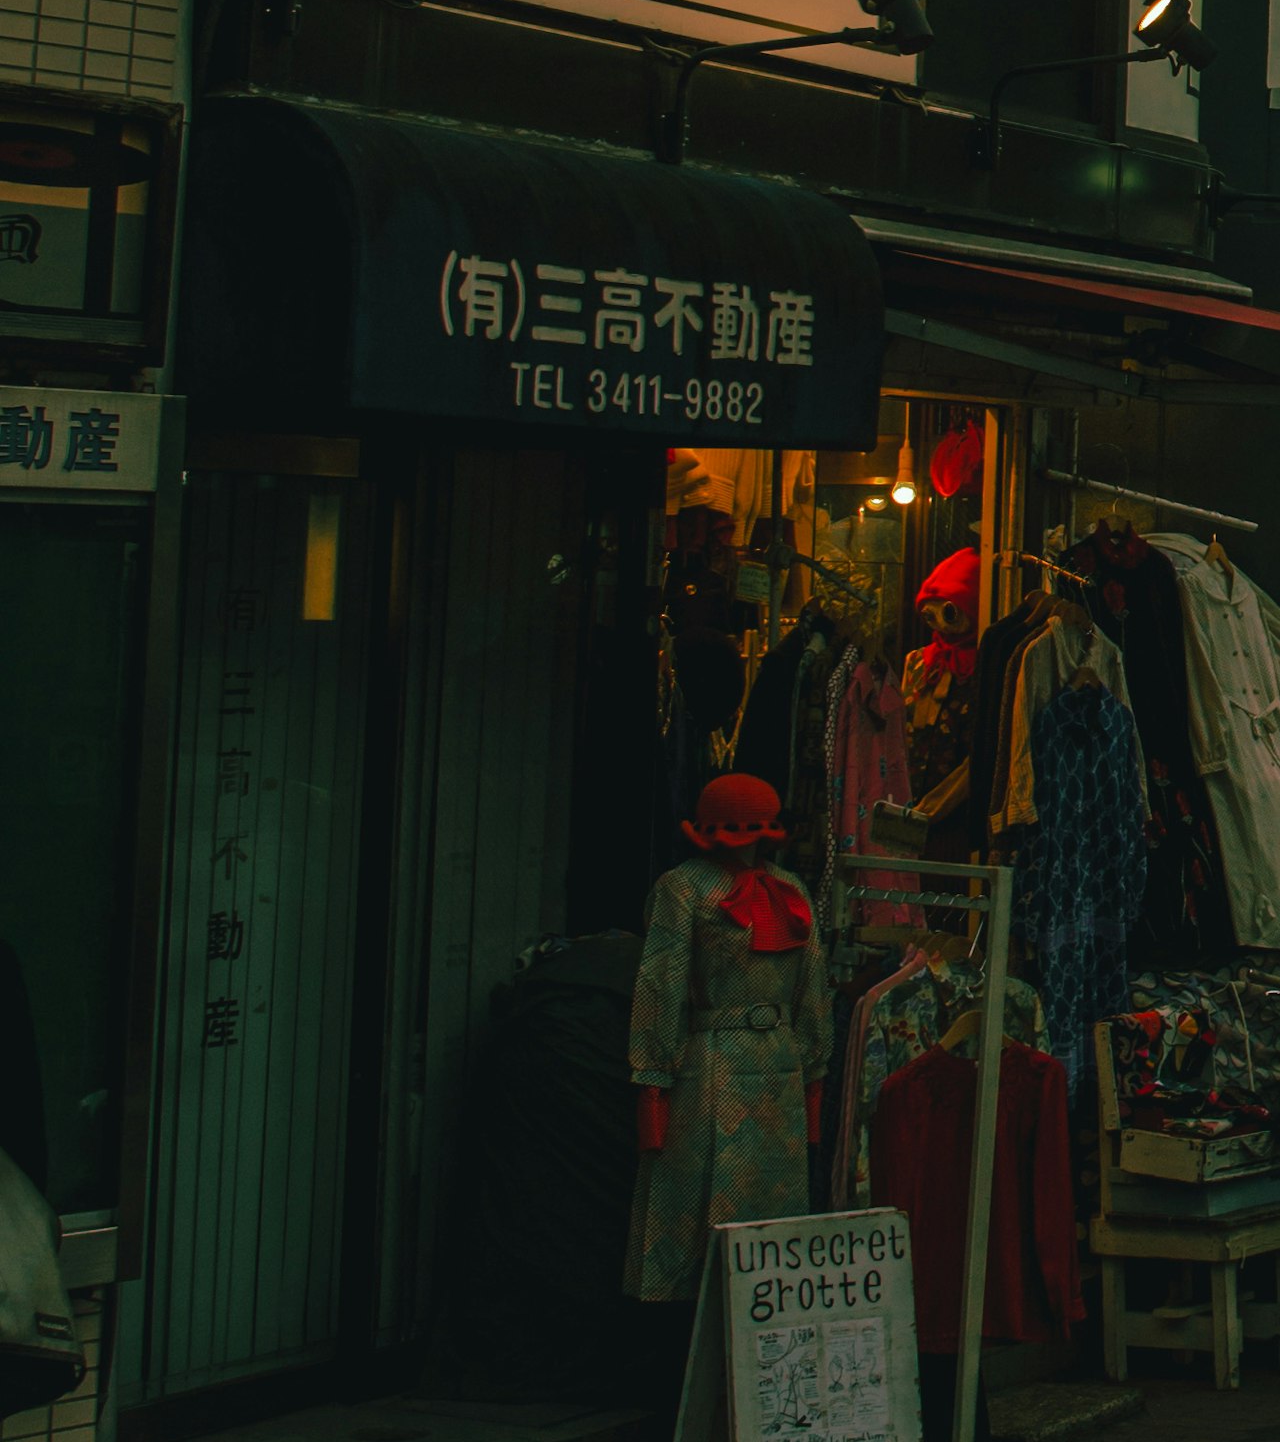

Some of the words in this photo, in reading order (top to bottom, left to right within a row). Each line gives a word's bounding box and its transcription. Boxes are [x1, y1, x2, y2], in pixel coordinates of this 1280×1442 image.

[440, 249, 815, 366] (有)三高不動産
[510, 361, 574, 411] TEL
[588, 367, 765, 424] 3411-9882
[734, 1224, 906, 1275] unsecret
[749, 1268, 883, 1324] grotte
